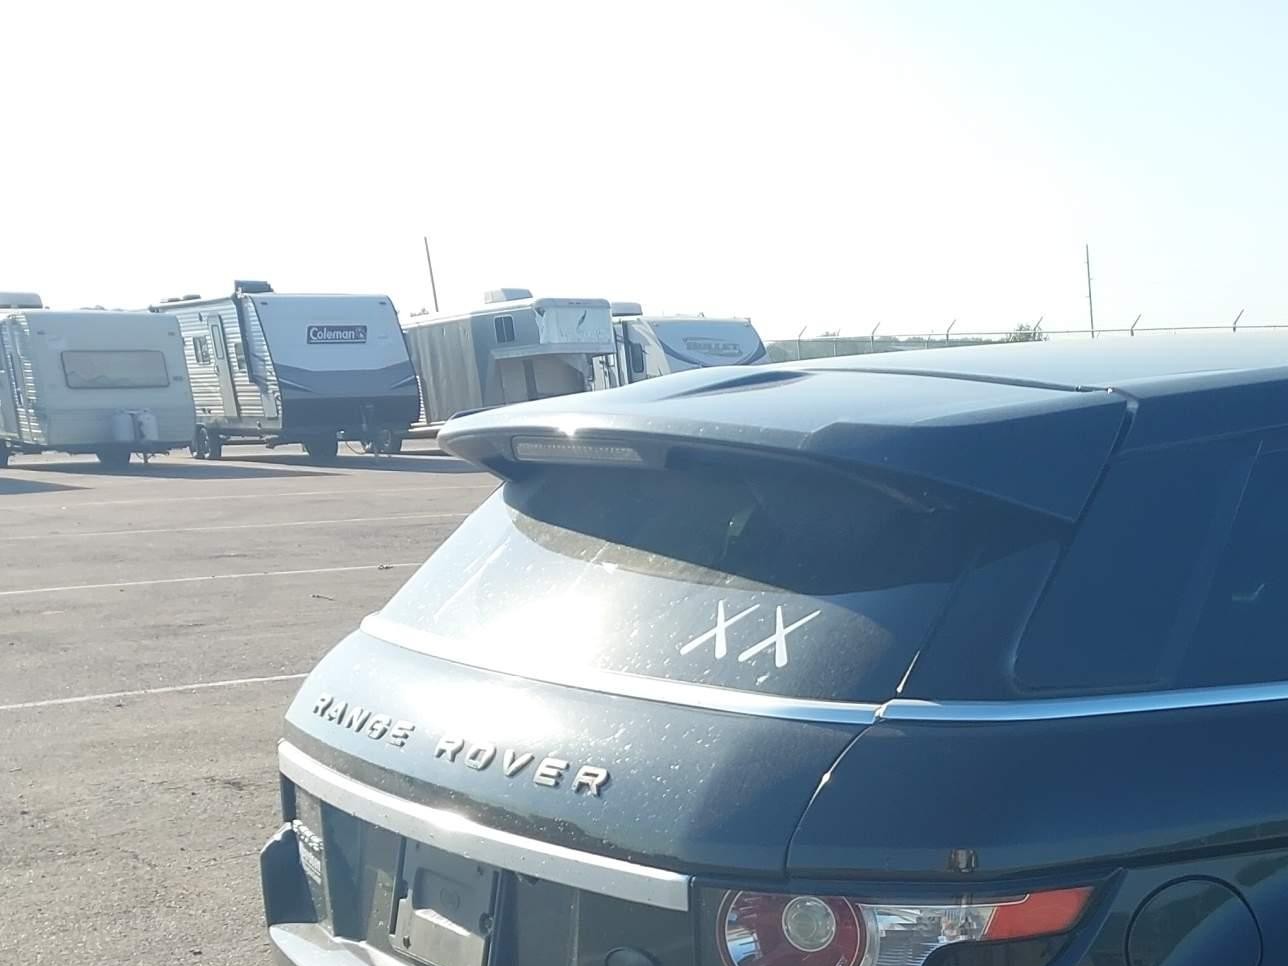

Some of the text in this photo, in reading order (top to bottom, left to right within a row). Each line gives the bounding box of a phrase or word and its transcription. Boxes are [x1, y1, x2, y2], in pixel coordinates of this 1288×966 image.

[310, 327, 356, 341] Coleman
[311, 696, 610, 798] RANGE ROVER
